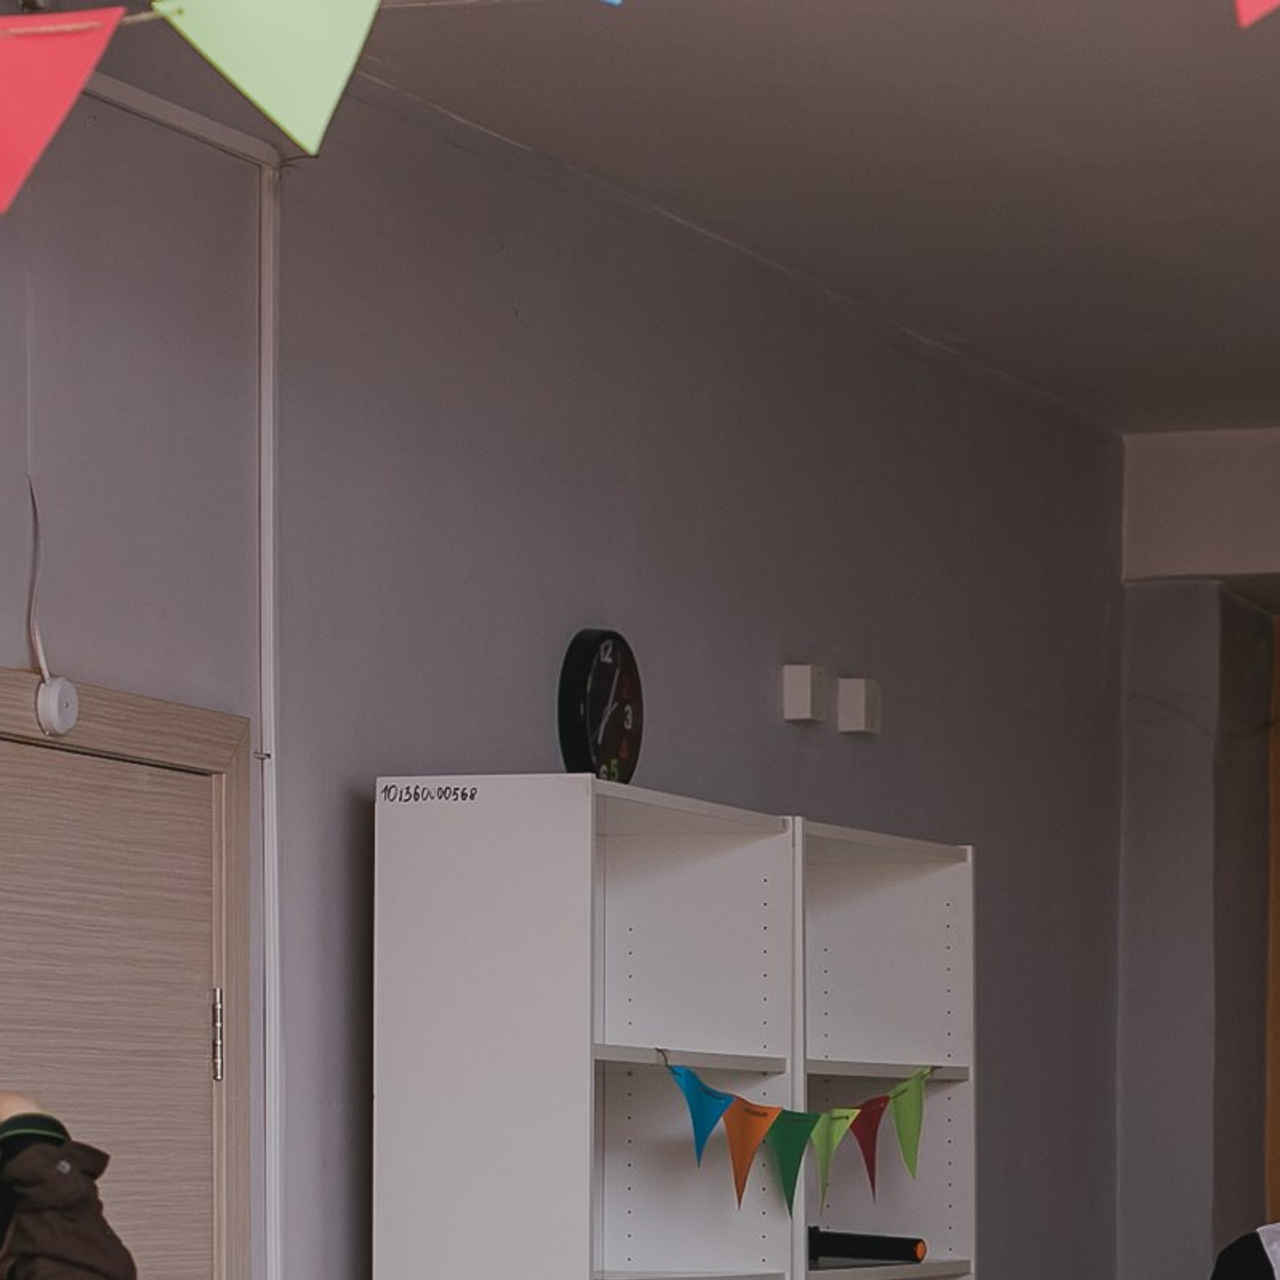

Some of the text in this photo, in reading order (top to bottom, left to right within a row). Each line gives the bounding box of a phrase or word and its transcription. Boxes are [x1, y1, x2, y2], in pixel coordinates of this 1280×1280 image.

[599, 639, 614, 664] 12
[623, 704, 633, 730] 3
[610, 758, 619, 781] 5
